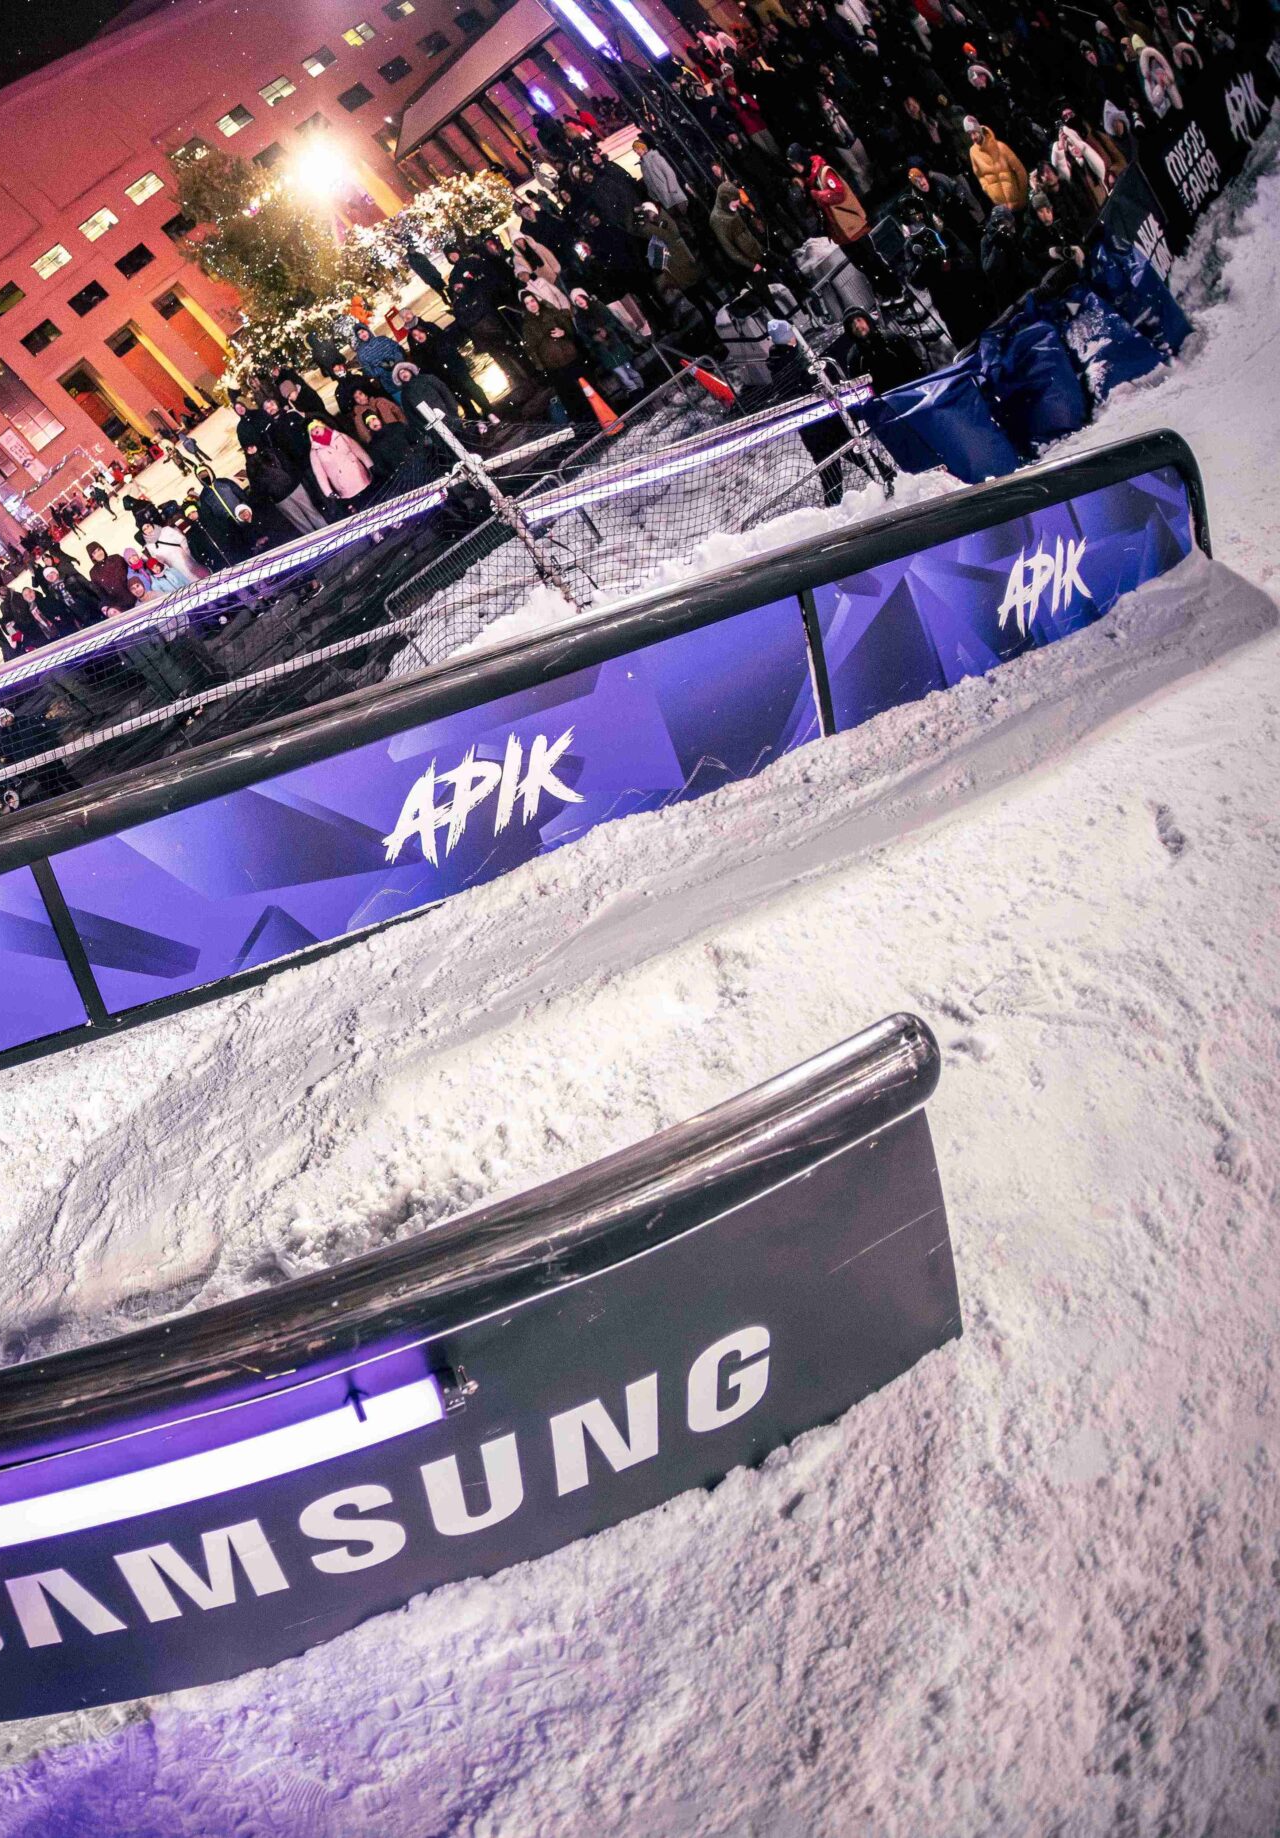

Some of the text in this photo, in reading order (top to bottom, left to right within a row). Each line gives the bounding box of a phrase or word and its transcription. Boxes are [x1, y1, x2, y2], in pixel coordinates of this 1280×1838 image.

[1225, 71, 1269, 146] APIK
[1165, 121, 1206, 186] MISSIS
[1183, 149, 1221, 211] SAUGA
[997, 534, 1093, 637] APIK
[381, 725, 587, 868] APIK
